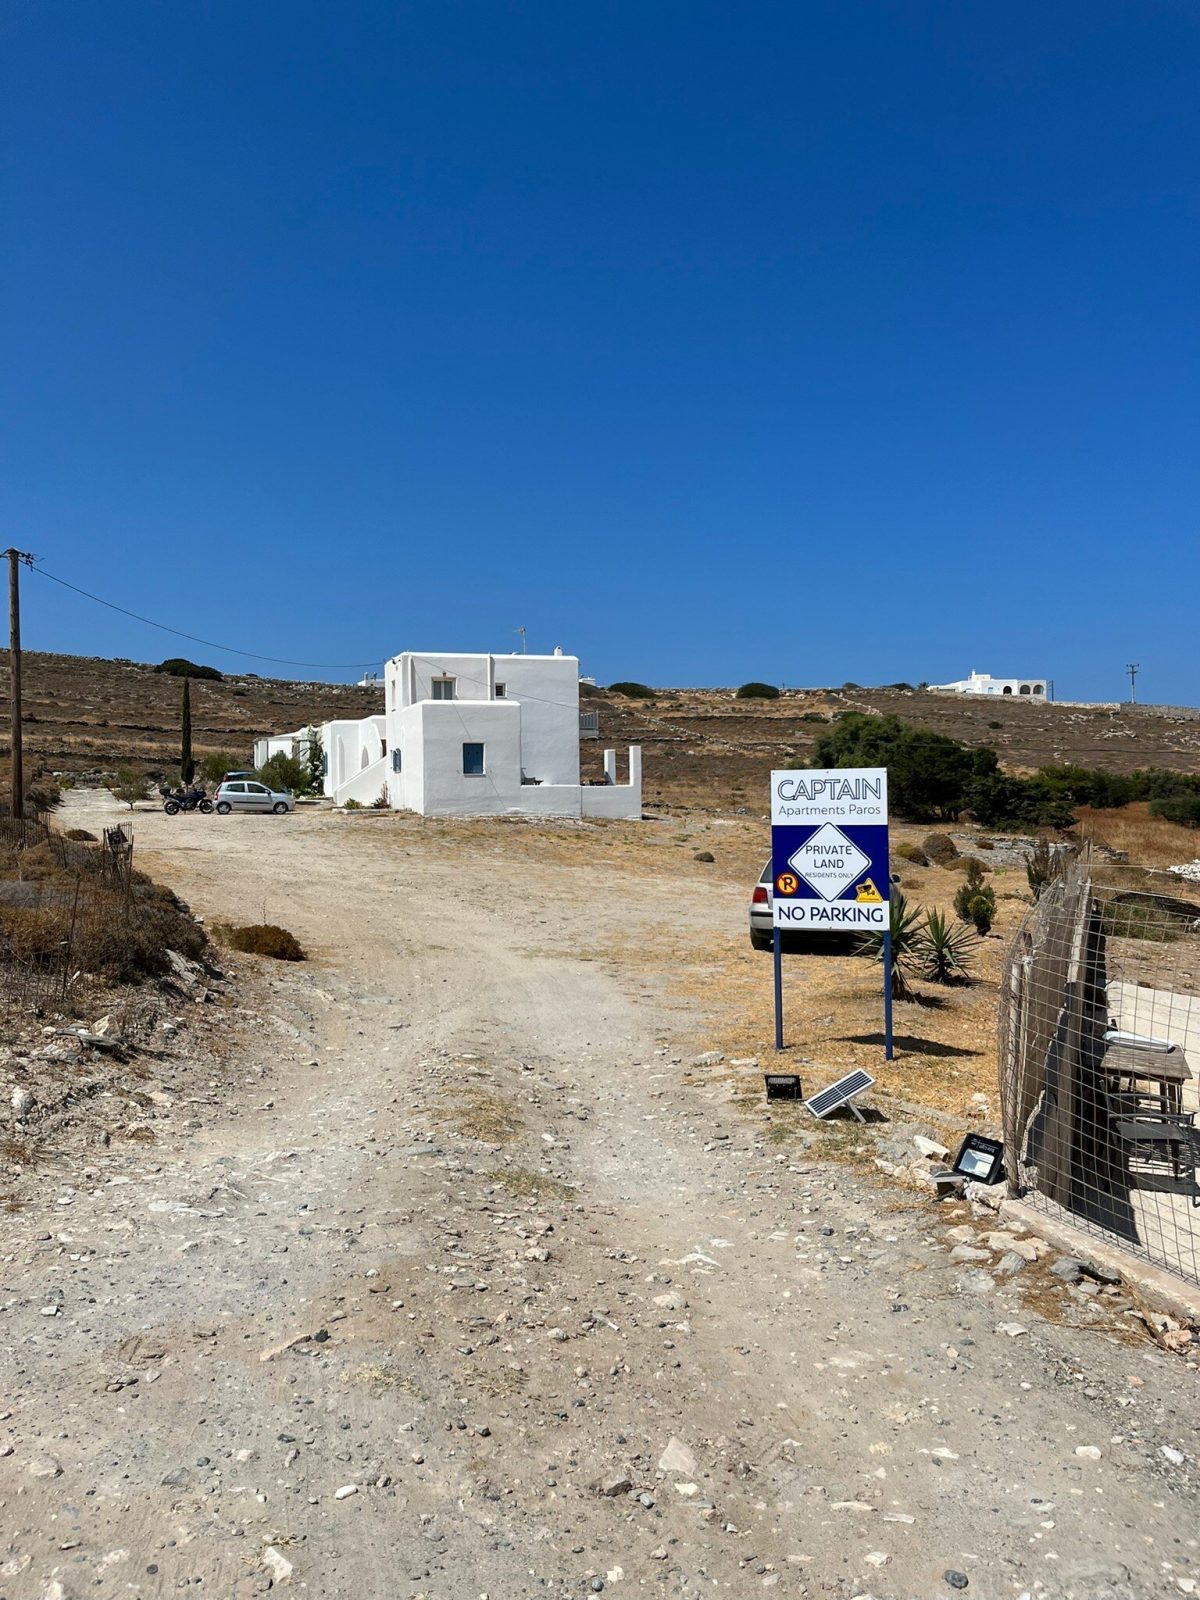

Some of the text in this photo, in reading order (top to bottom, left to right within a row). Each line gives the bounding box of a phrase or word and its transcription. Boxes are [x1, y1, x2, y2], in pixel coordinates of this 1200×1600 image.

[777, 778, 881, 801] CAPTAIN
[778, 804, 881, 818] Apartments Paros
[805, 845, 852, 855] PRIVATE
[813, 859, 845, 869] LAND
[778, 906, 884, 923] NO PARKING
